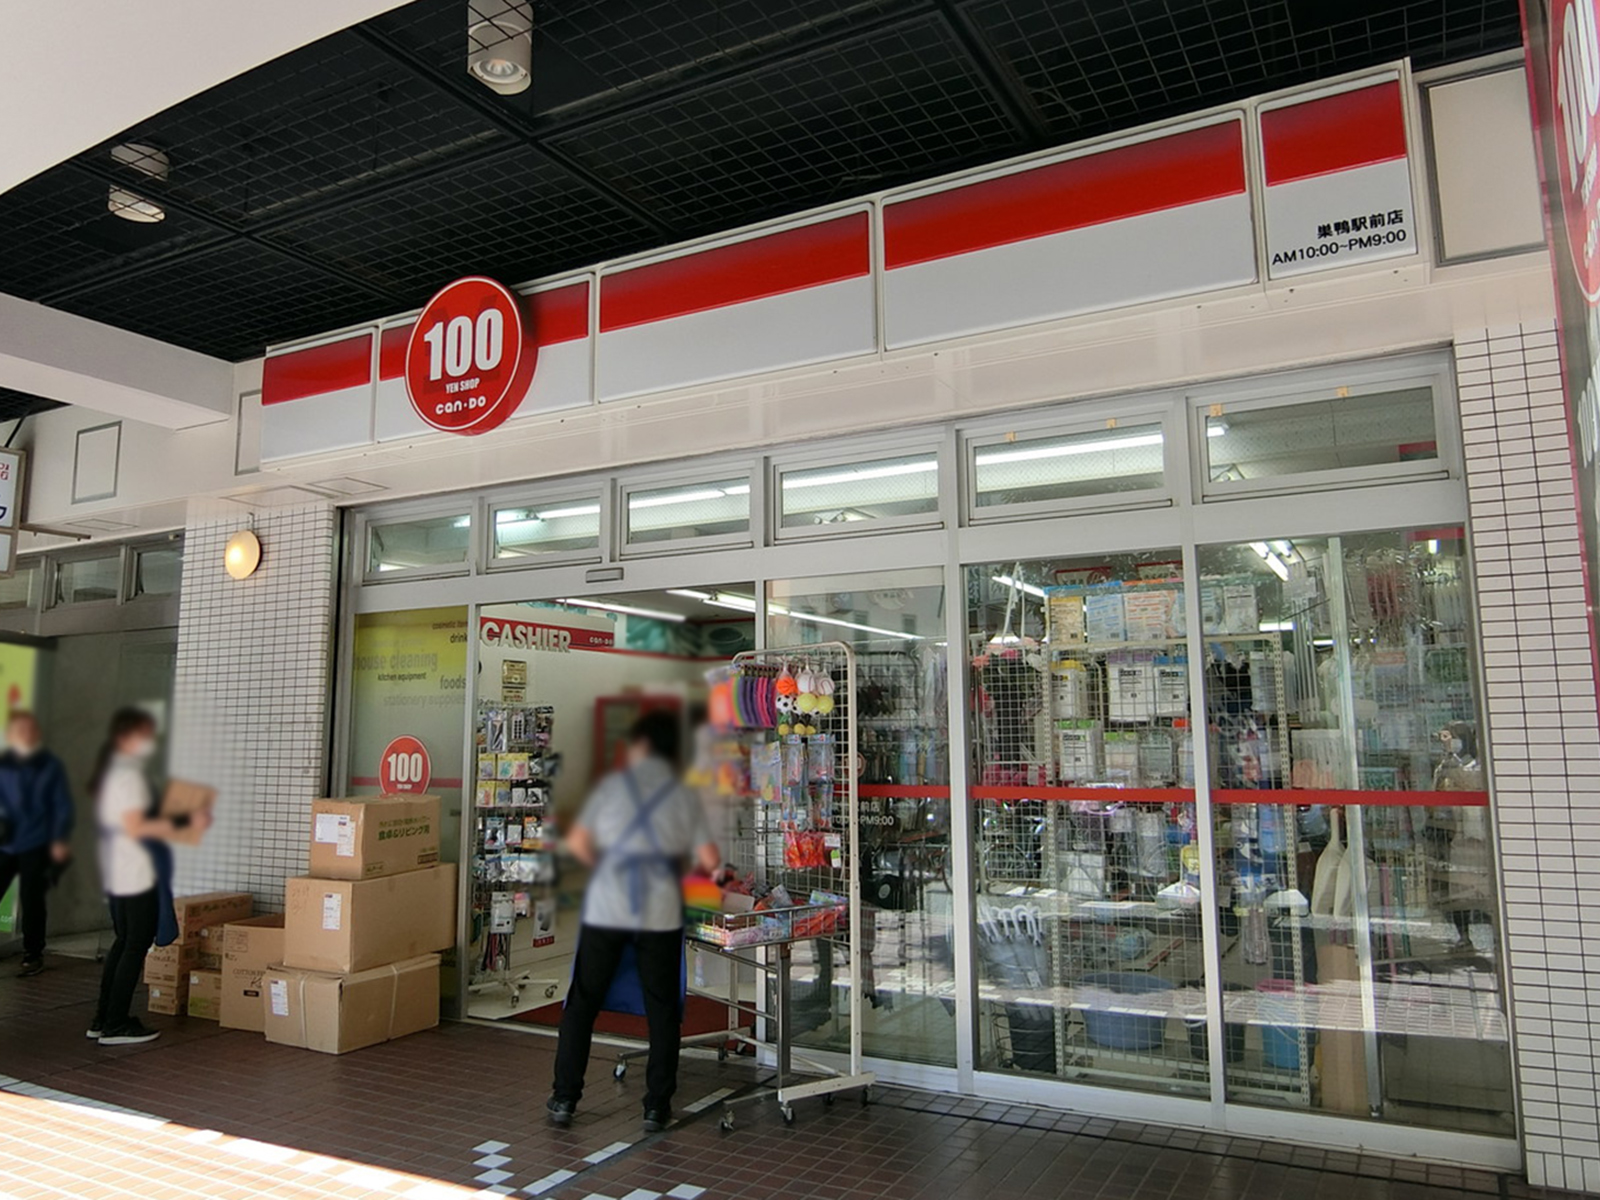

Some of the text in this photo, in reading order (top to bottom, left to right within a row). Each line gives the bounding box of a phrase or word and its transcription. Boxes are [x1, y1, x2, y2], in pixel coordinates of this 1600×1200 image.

[1317, 209, 1403, 239] 巣鴨駅前店
[424, 308, 504, 381] 100
[446, 377, 480, 394] YEN SHOP
[481, 621, 572, 653] CASHIER
[390, 649, 438, 673] cleaning
[377, 671, 427, 683] kitchen equipment
[440, 674, 467, 690] foods
[387, 752, 423, 783] 100
